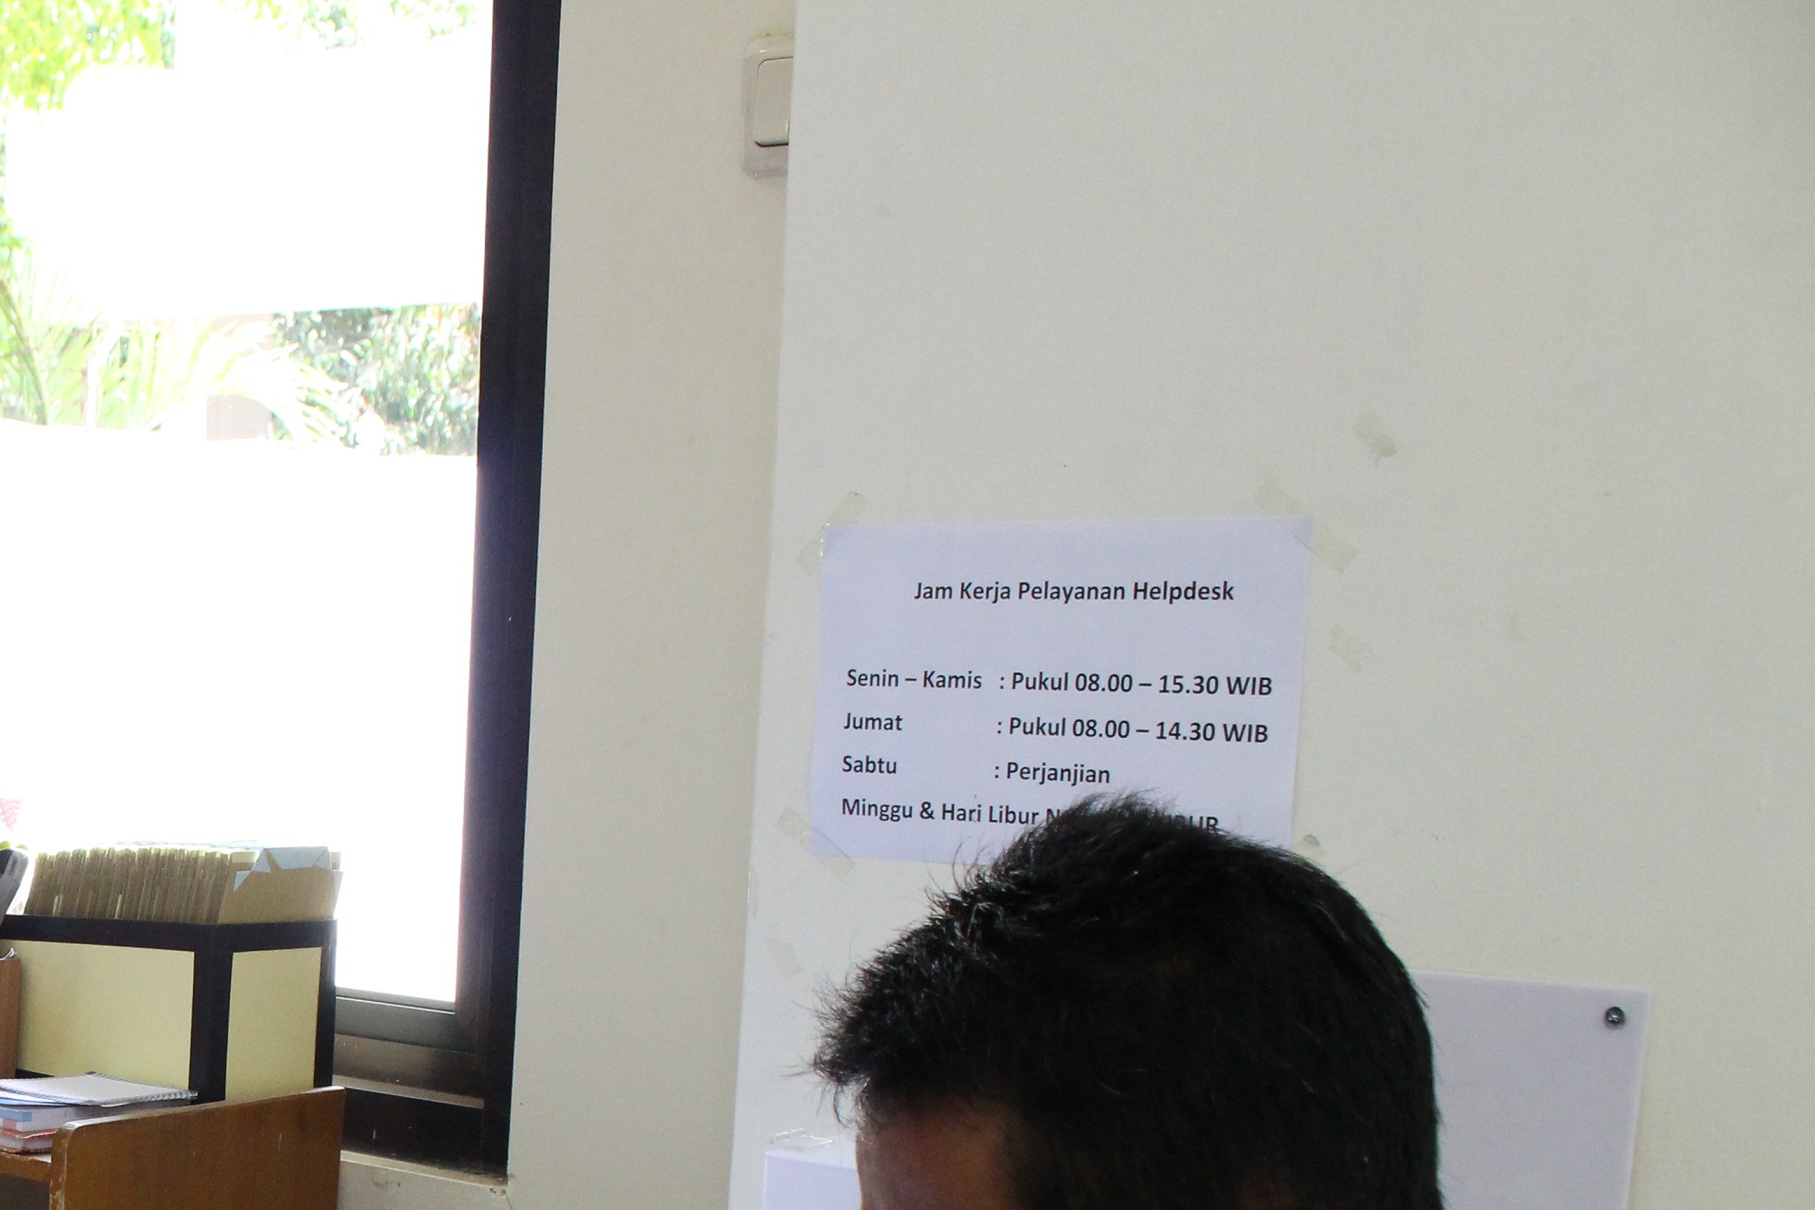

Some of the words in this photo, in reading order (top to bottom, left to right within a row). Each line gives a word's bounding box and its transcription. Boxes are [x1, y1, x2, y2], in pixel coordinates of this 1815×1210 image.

[914, 582, 952, 599] Jam
[960, 581, 1010, 604] Kerja
[1019, 581, 1125, 604] Pelayanan
[1134, 581, 1234, 604] Helpdesk
[847, 669, 898, 687] Senin
[924, 671, 981, 689] Kamis
[1012, 672, 1068, 691] Pukul
[1075, 673, 1133, 692] 08.00
[1159, 675, 1219, 694] 15.30
[1227, 677, 1272, 695] WIB
[844, 713, 902, 731] Jumat
[1010, 717, 1066, 736] Pukul
[1073, 719, 1130, 738] 08.00
[1156, 722, 1215, 741] 14.30
[1223, 724, 1268, 743] WIB
[842, 755, 896, 774] Sabtu
[1007, 762, 1110, 786] Perjanjian
[842, 799, 912, 822] Minggu
[920, 802, 934, 819] &
[942, 803, 981, 822] Hari
[989, 805, 1039, 825] Libur
